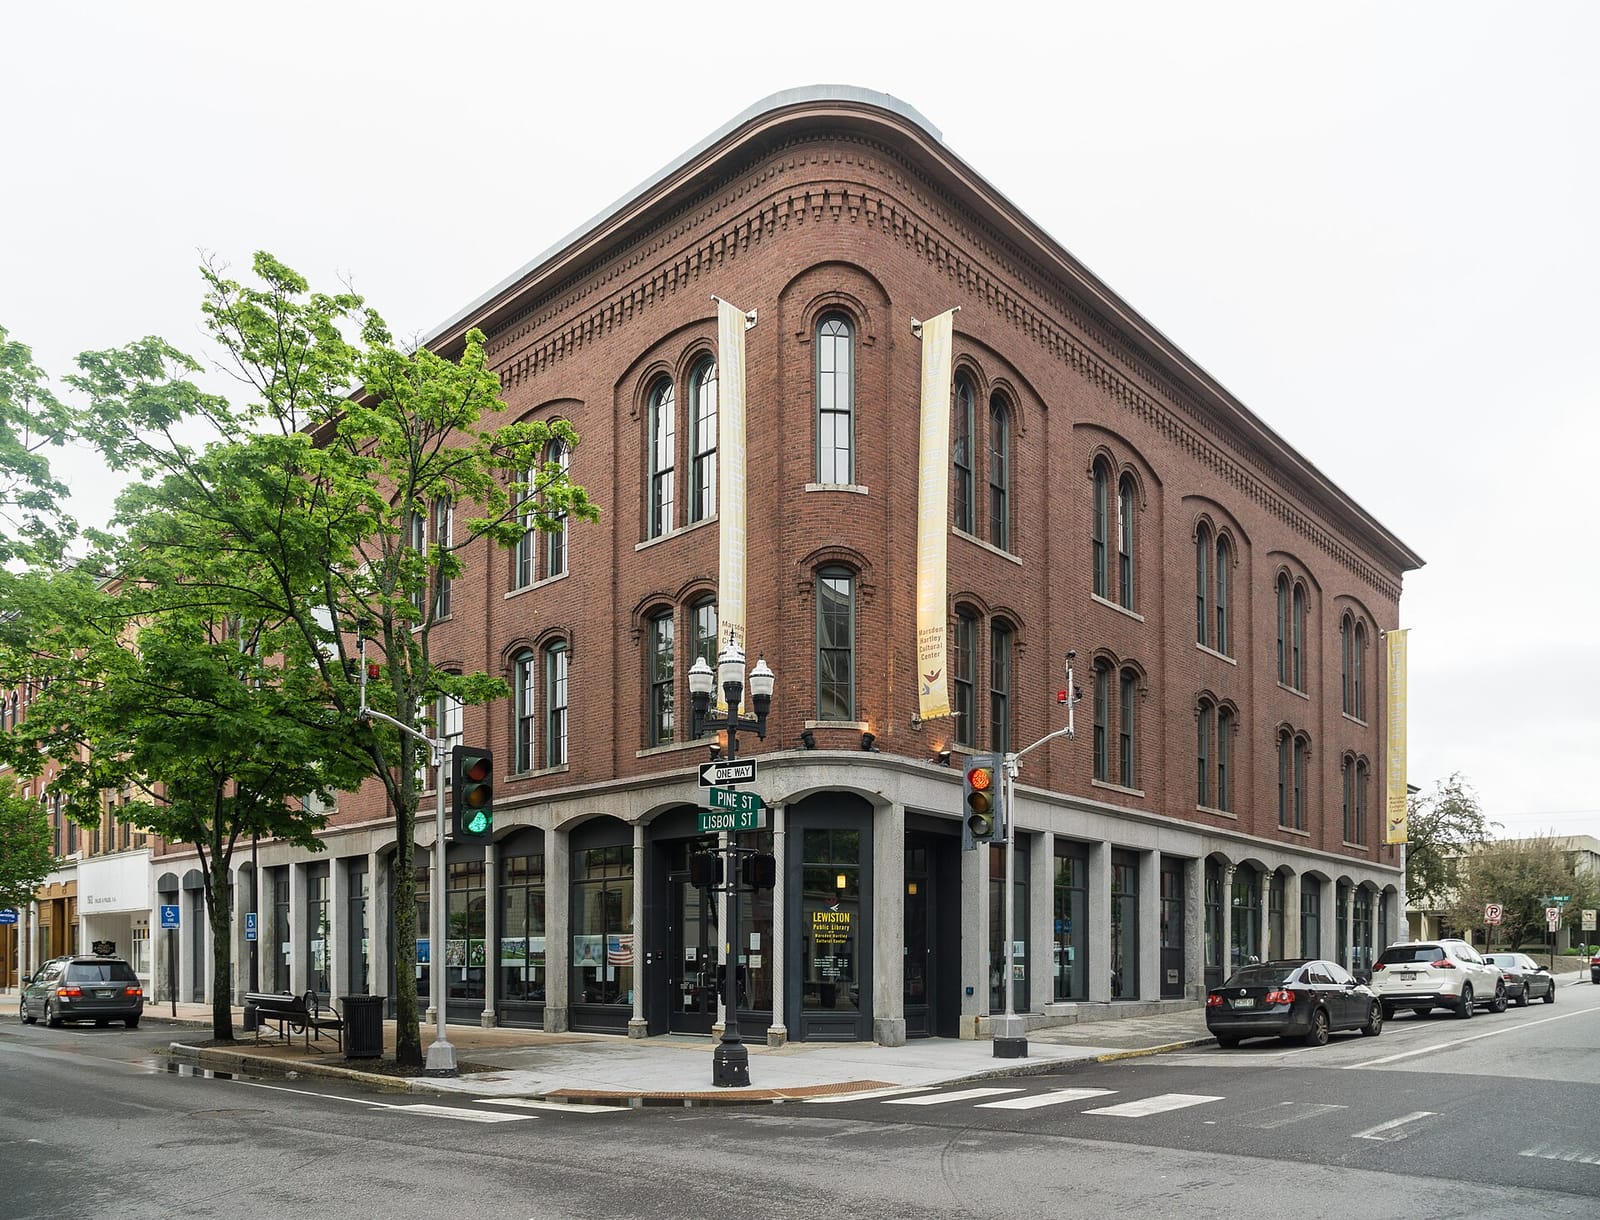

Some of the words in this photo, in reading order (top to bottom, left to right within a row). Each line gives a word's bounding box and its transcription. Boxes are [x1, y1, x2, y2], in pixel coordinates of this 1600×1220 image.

[922, 448, 945, 520] Public
[920, 528, 944, 613] Library
[919, 626, 943, 636] Marsden
[920, 634, 941, 644] Hartley
[919, 642, 943, 652] Cultural
[920, 652, 940, 661] Center
[716, 768, 732, 779] ONE
[734, 767, 751, 777] WAY
[717, 791, 738, 808] PINE
[741, 795, 753, 809] ST
[703, 814, 735, 829] LISBON
[741, 812, 753, 826] ST
[812, 911, 850, 923] LEWISTON
[831, 924, 850, 932] Library
